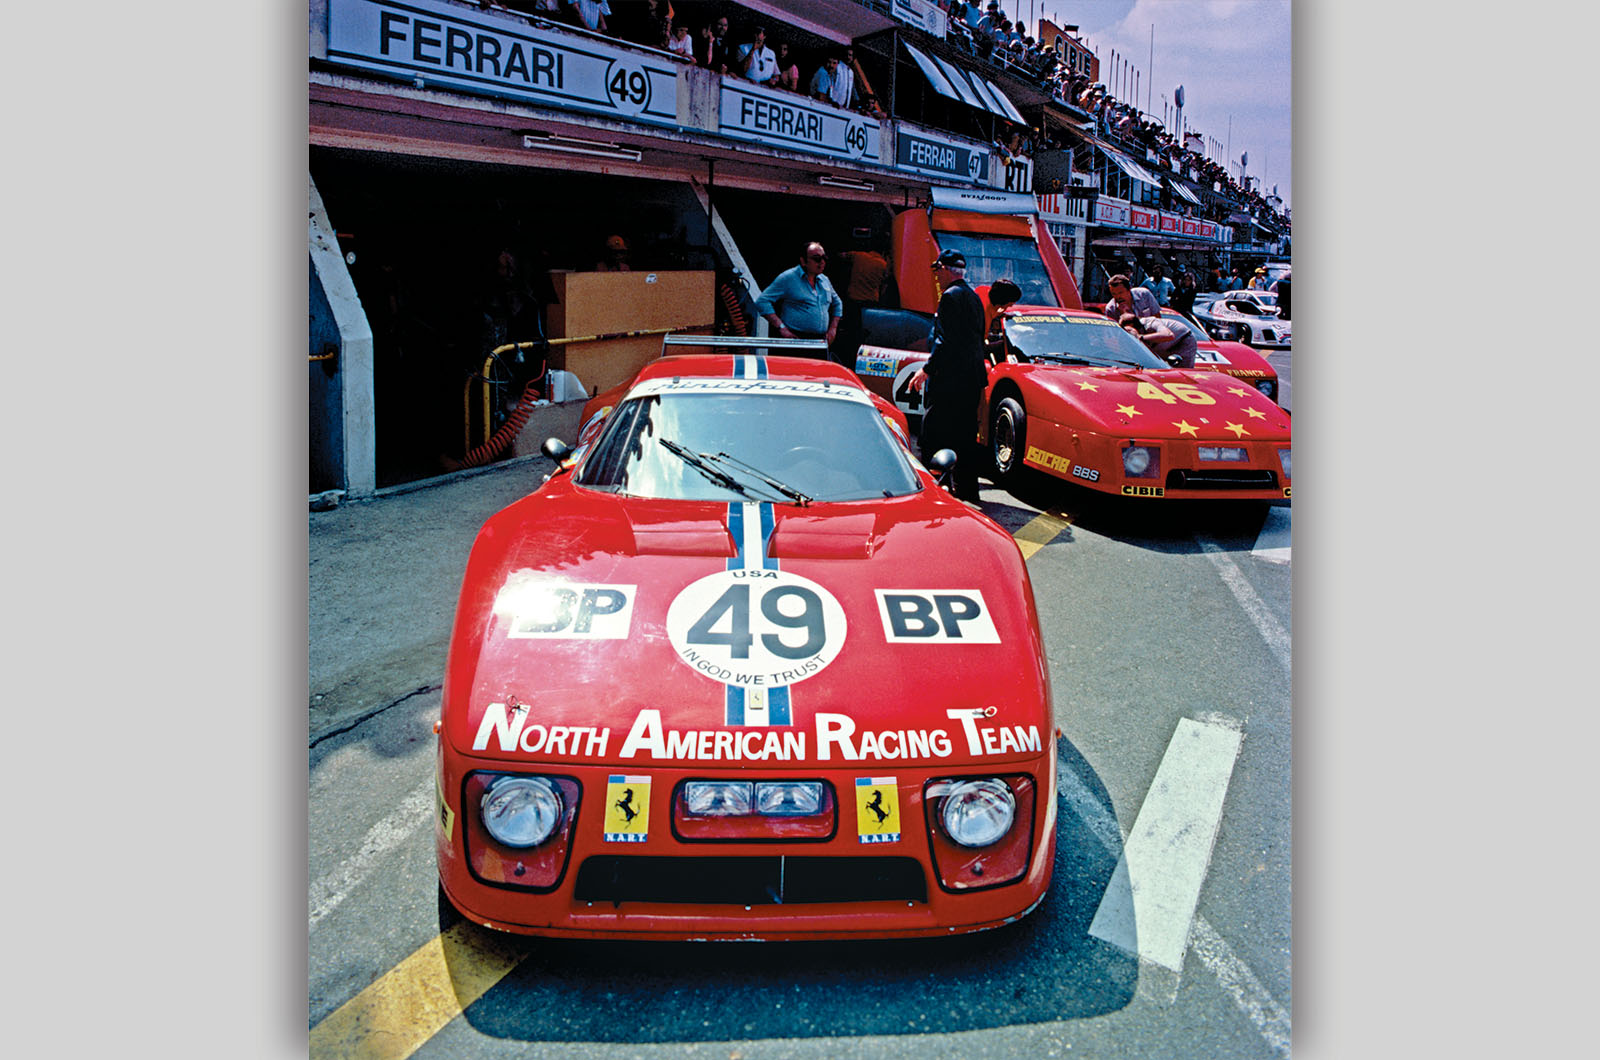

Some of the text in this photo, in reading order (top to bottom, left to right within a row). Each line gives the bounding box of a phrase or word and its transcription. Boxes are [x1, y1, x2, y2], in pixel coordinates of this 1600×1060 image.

[380, 10, 647, 105] FERRARI 49
[741, 96, 866, 151] FERRARI 46
[910, 140, 980, 173] FERRARI 47
[960, 193, 1007, 201] GOODYEAR
[895, 371, 923, 411] 4
[1226, 369, 1266, 377] FRANCE
[1136, 382, 1217, 405] 46
[1072, 465, 1099, 481] BBS
[1122, 486, 1164, 497] CIBIE
[733, 571, 778, 579] USA
[518, 588, 628, 633] BP
[686, 583, 827, 660] 49
[883, 594, 982, 638] BP
[682, 648, 827, 685] IN GOD WE TRUST
[472, 703, 1042, 760] NORTH AMERICAN RACING TEAM
